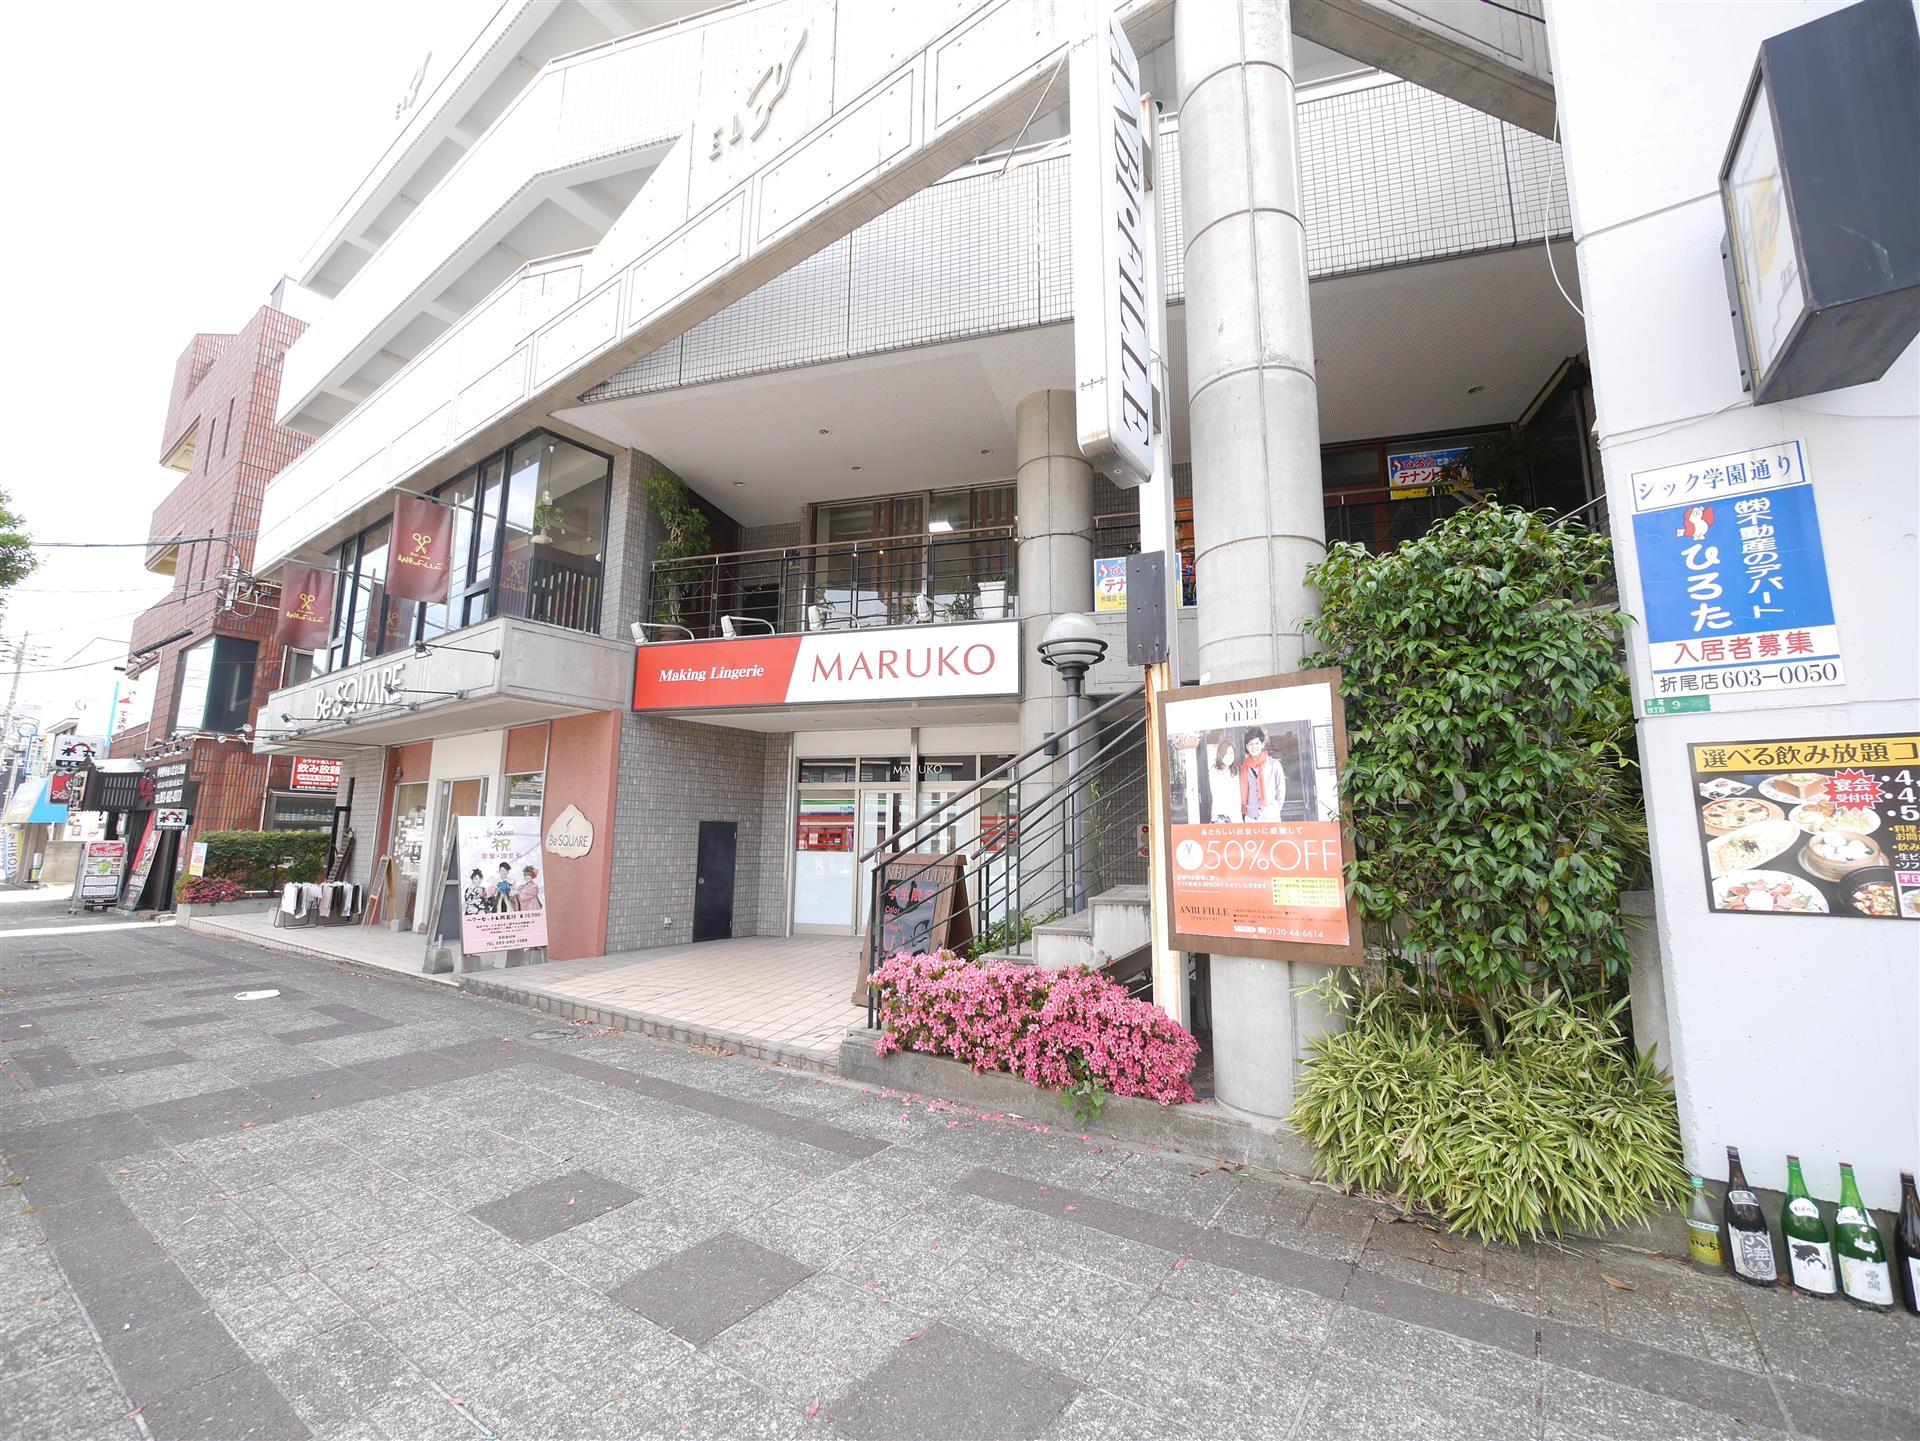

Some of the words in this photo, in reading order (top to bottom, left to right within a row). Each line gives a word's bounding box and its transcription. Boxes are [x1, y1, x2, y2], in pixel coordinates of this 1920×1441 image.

[1639, 454, 1791, 501] シック学園通り
[1680, 544, 1733, 633] ひろた
[1674, 630, 1815, 665] 入居者募集
[812, 643, 996, 683] MARUKO
[658, 667, 706, 683] Making
[710, 664, 765, 681] Lingerie
[332, 663, 405, 716] SQUARE
[1660, 674, 1718, 693] 折尾店
[1228, 697, 1258, 711] ANBI
[1224, 710, 1262, 723] FILLE
[892, 764, 943, 775] MAUKO
[1833, 778, 1871, 792] 宴会
[1836, 793, 1874, 803] 受付中
[548, 834, 557, 847] Be
[558, 834, 588, 848] SQUARE
[1203, 839, 1337, 871] 50%OFF
[1179, 906, 1200, 915] ANBI
[1201, 907, 1229, 916] FILLE
